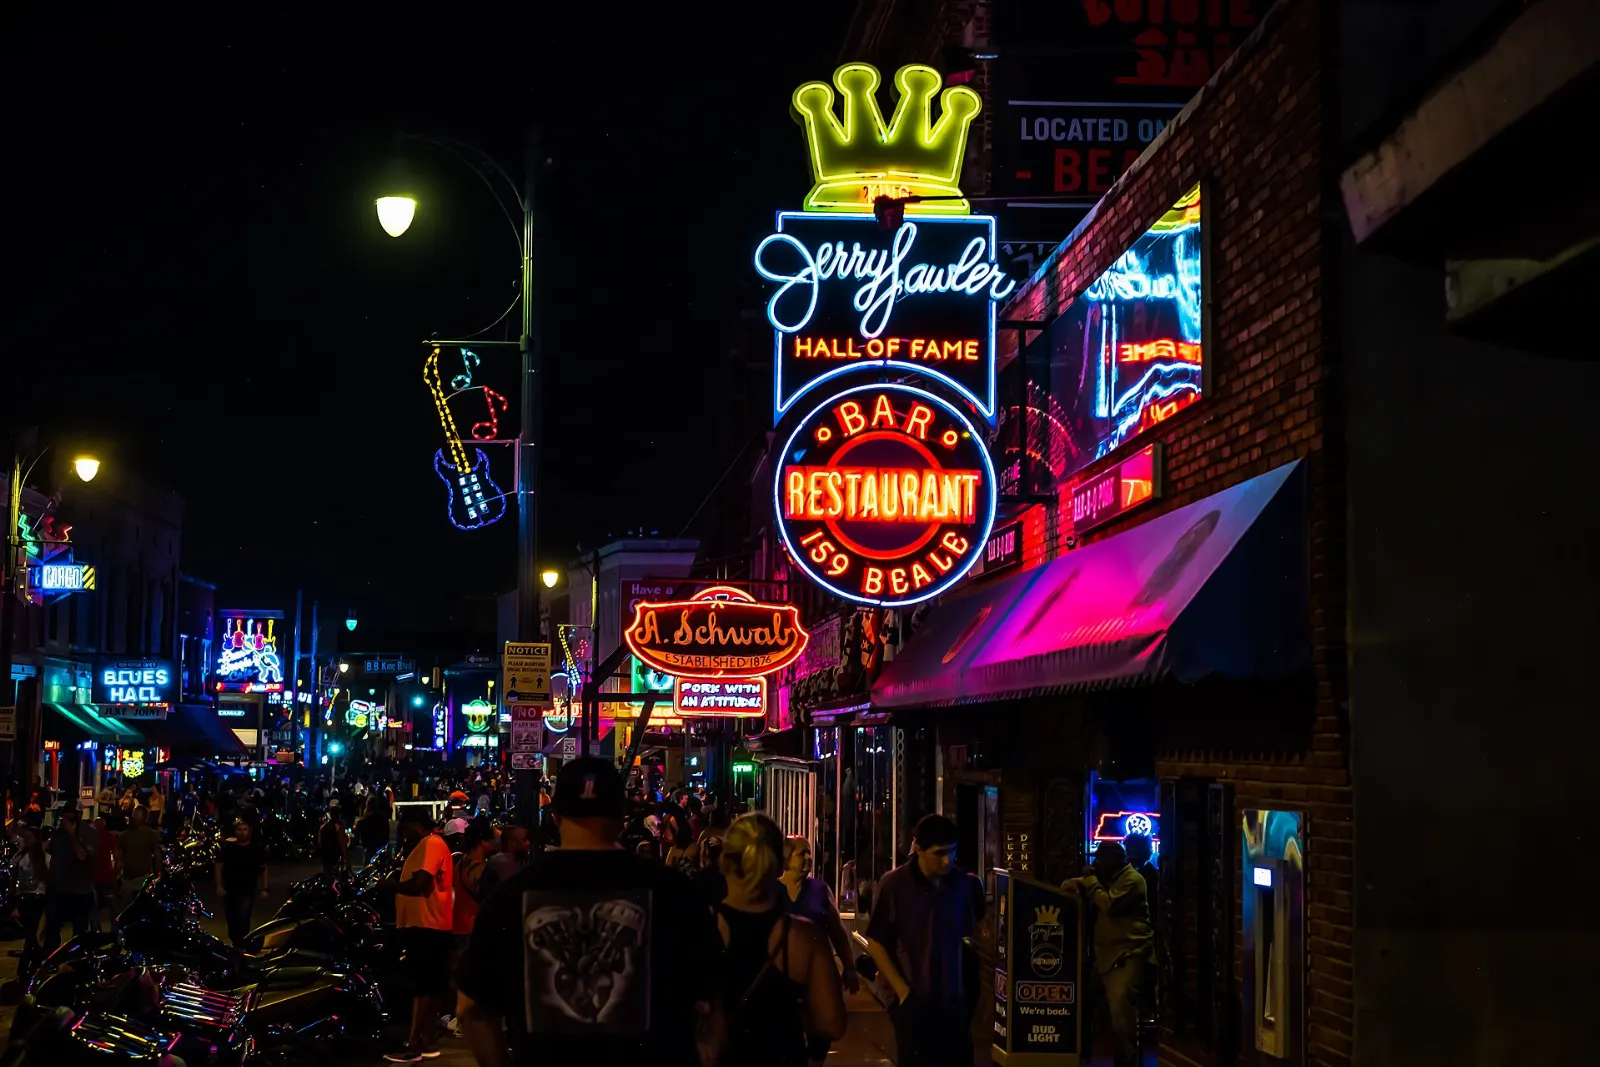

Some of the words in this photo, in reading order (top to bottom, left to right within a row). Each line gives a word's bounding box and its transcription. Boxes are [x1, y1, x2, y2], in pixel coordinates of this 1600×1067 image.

[1020, 116, 1128, 142] LOCATED
[755, 232, 888, 333] Jerry
[860, 222, 1016, 339] Lawler
[795, 337, 861, 358] HALL
[867, 338, 901, 358] OF
[911, 338, 979, 360] FAME
[835, 394, 934, 440] BAR
[787, 471, 980, 518] RESTAURANT
[801, 530, 849, 576] 159
[863, 530, 970, 595] BEALE
[631, 584, 662, 595] Have
[666, 587, 673, 595] a
[634, 610, 669, 645] A.
[673, 610, 792, 646] Schwab
[508, 646, 547, 655] NOTICE
[665, 653, 747, 668] ESTABLISHED
[750, 655, 772, 667] 1876
[104, 670, 169, 685] BLUES
[110, 687, 161, 702] HALL
[680, 683, 721, 694] PORK
[724, 683, 761, 694] WITH
[680, 696, 698, 707] AN
[104, 707, 126, 716] JUKE
[135, 707, 160, 717] JOINT
[518, 707, 536, 718] NO
[564, 745, 575, 753] 20
[1018, 983, 1073, 1002] OPEN
[1019, 1006, 1045, 1016] We're
[1046, 1006, 1071, 1016] back.
[1031, 1025, 1056, 1034] BUD
[1027, 1033, 1060, 1043] LIGHT
